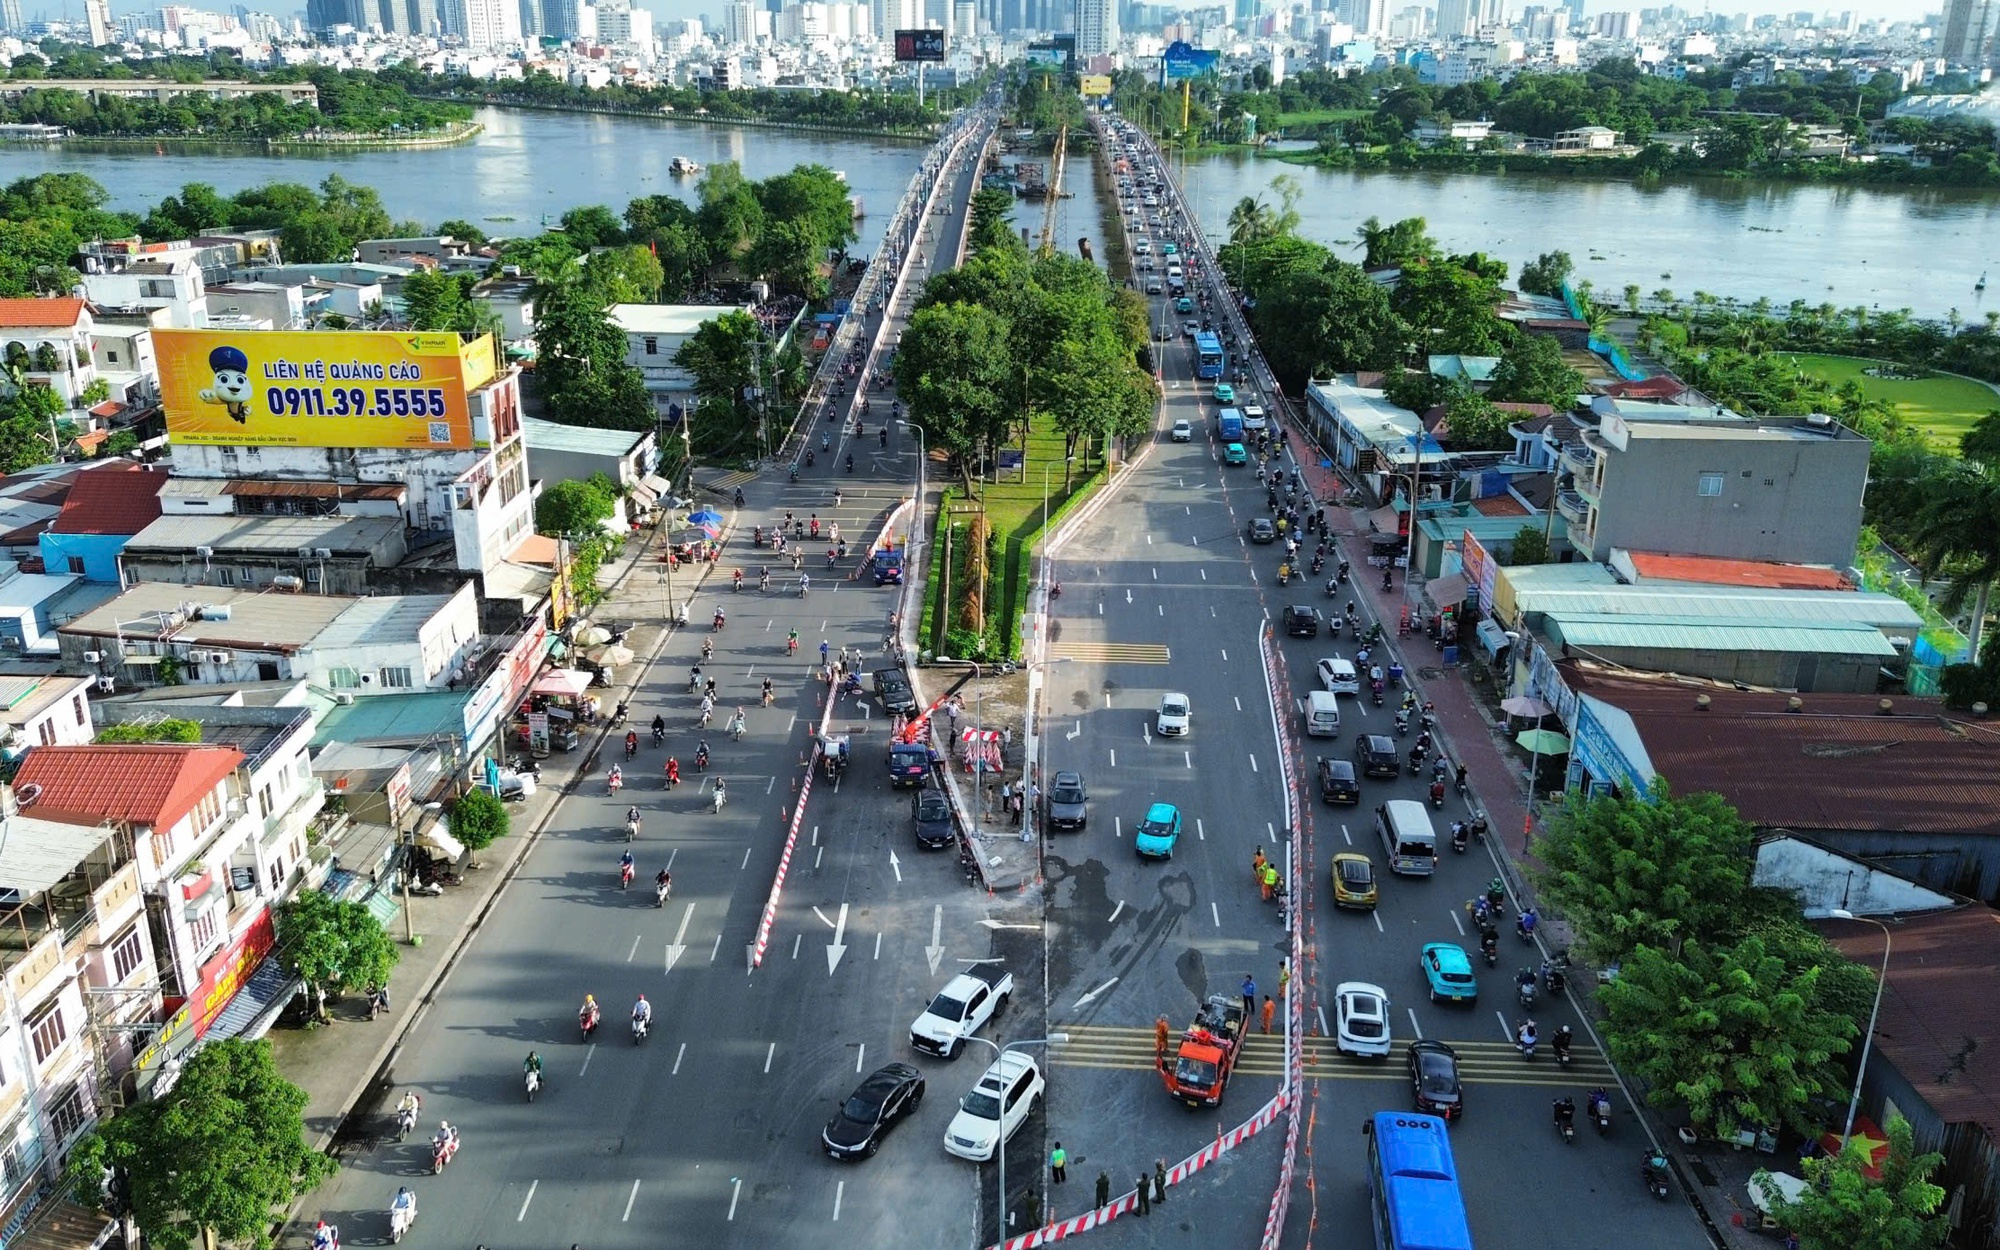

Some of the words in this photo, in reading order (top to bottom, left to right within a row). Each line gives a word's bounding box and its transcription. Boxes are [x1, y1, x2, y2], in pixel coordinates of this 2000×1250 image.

[264, 359, 299, 379] LIÊN
[304, 359, 325, 384] HỆ
[330, 360, 384, 380] QUẢNG
[389, 360, 420, 380] CÁO
[267, 387, 445, 418] 0911.39.5555
